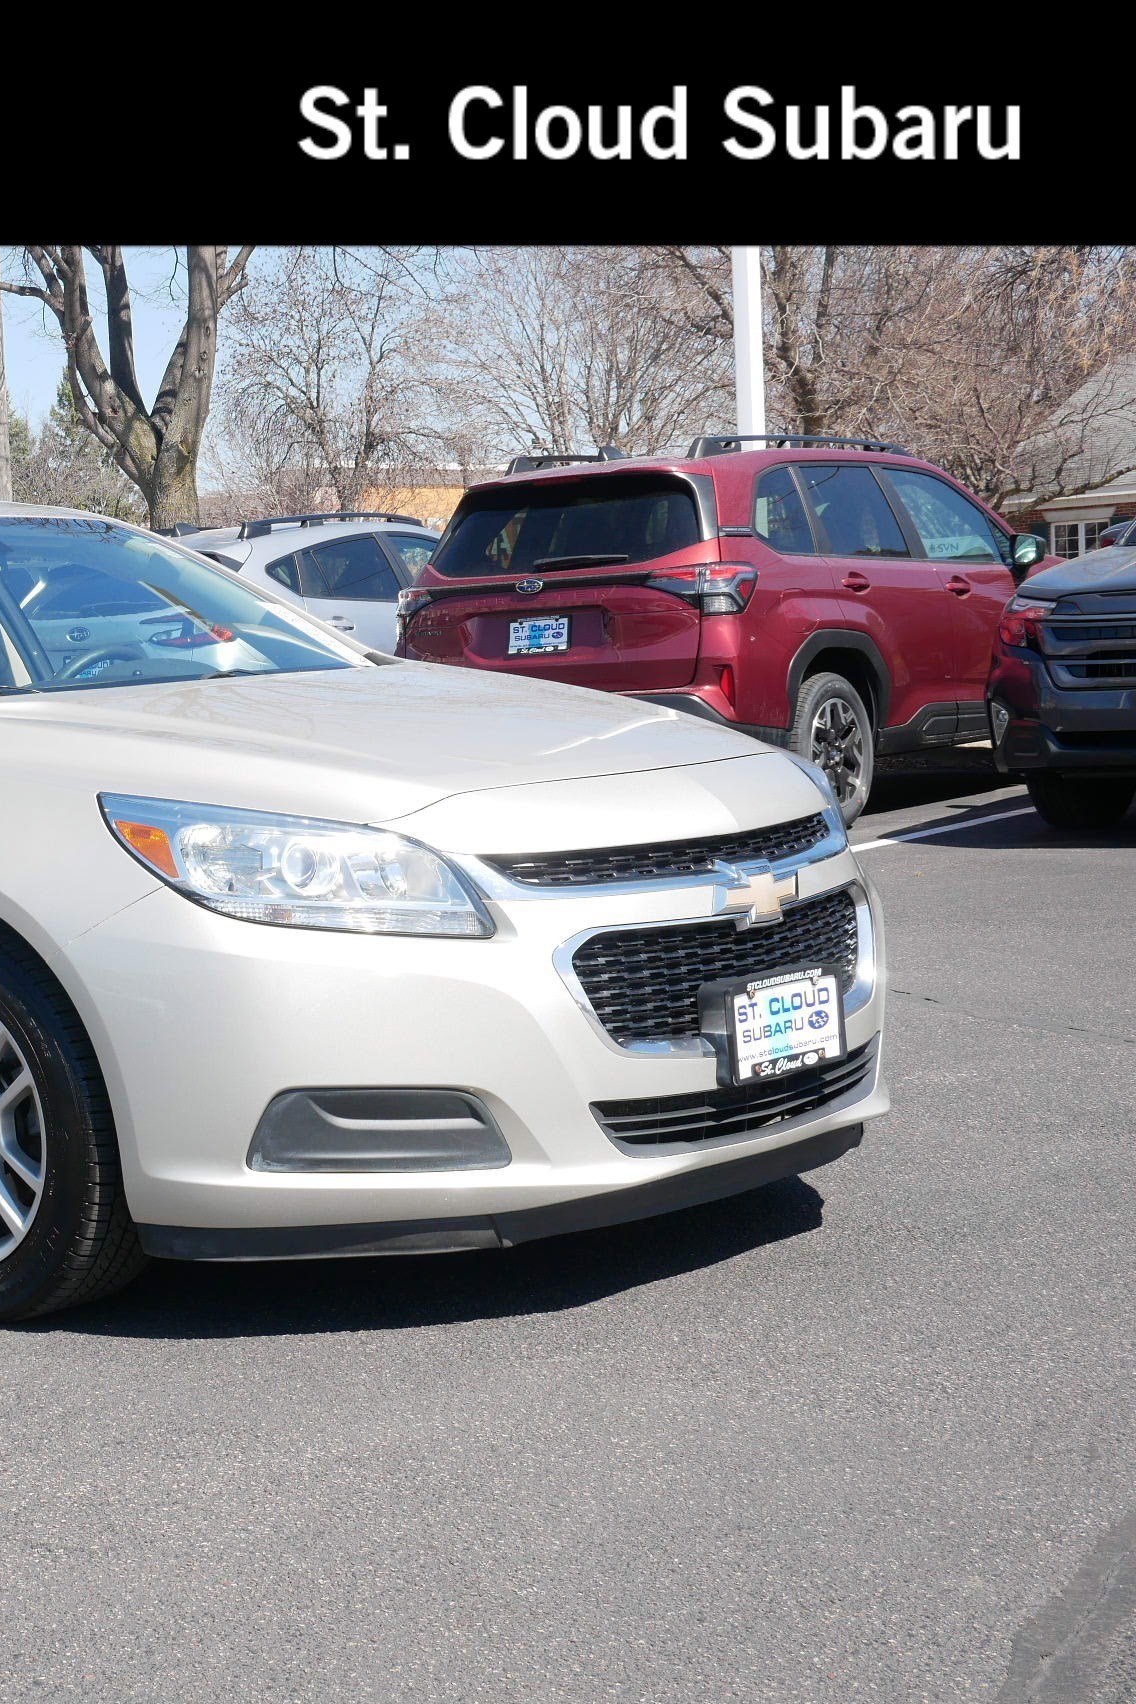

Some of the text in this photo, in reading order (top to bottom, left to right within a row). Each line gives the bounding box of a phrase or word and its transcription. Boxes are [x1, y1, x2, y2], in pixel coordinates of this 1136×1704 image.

[514, 633, 551, 642] SUBARU
[531, 622, 566, 632] CLOUD
[746, 968, 822, 991] STCLOUDSUBARU.COM
[737, 987, 830, 1023] ST. CLOUD
[742, 1016, 804, 1043] SUBARU
[759, 1054, 803, 1077] St. Cloud
